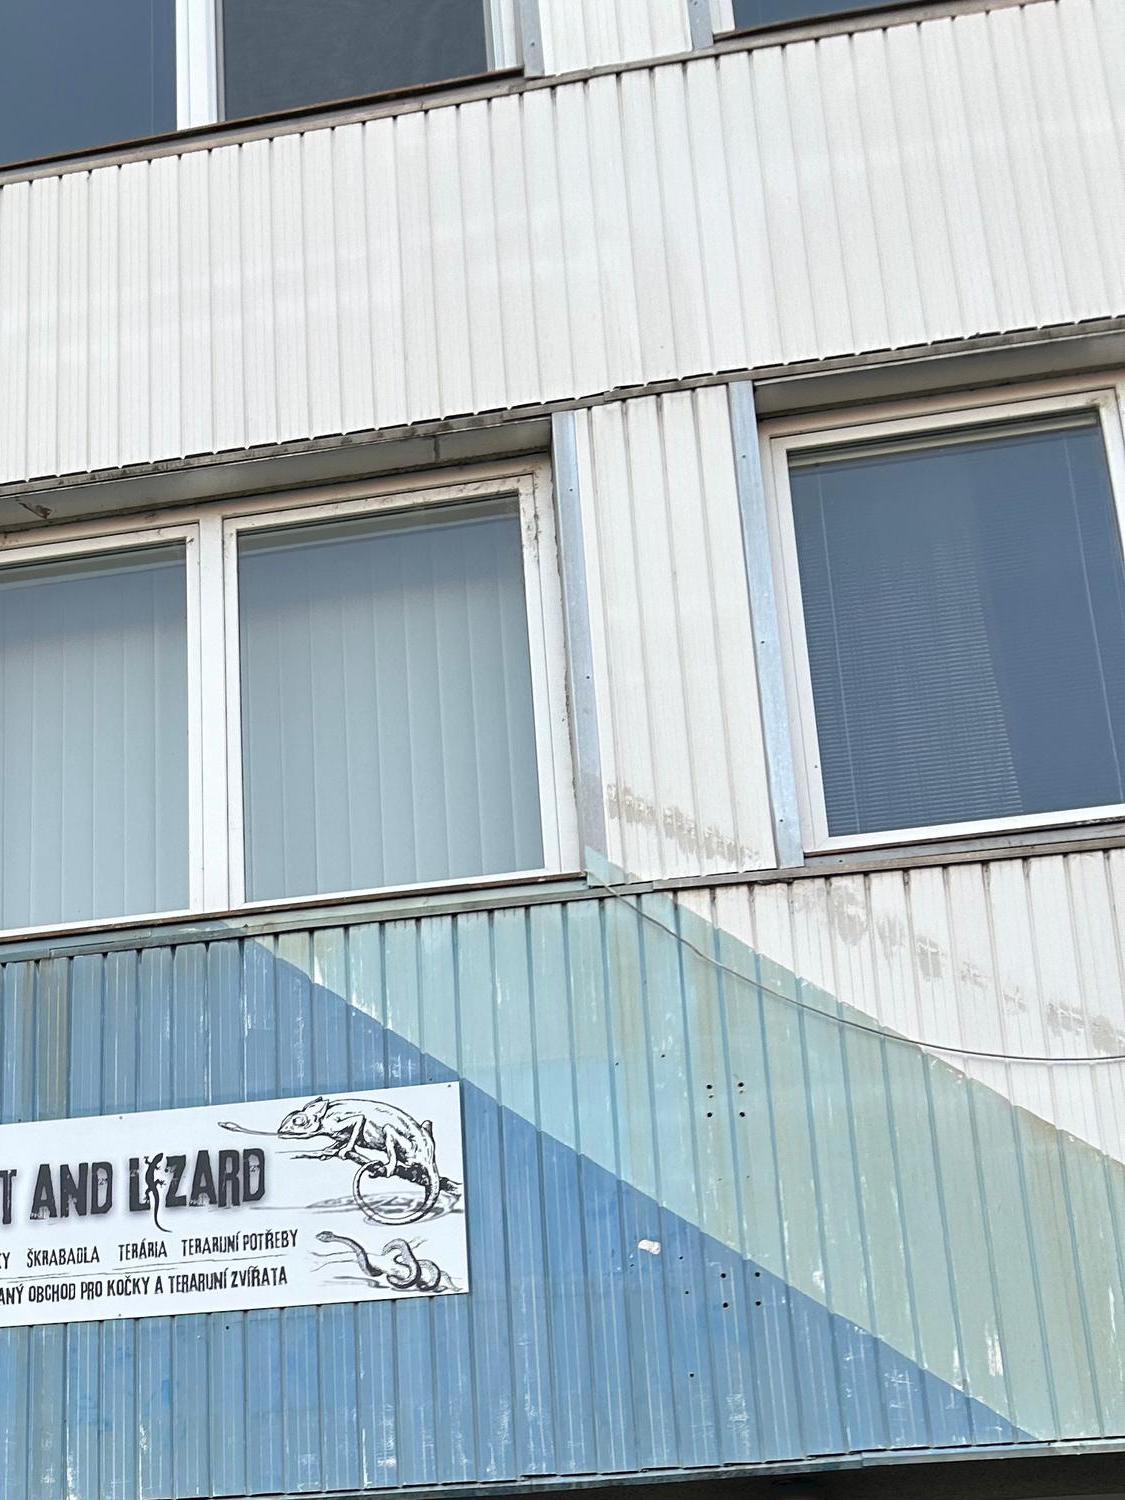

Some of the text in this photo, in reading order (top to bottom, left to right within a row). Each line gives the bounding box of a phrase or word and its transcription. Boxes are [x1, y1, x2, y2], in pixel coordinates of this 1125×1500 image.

[29, 1162, 113, 1220] AND
[26, 1245, 100, 1268] ŠKRABADLA
[118, 1238, 168, 1262] TERÁRIA
[242, 1228, 299, 1252] POTŘEBY
[28, 1282, 76, 1304] OBCHOD
[80, 1280, 103, 1301] PRO
[106, 1274, 150, 1297] KOČKY
[154, 1275, 164, 1295] A
[230, 1265, 288, 1289] ZVÍŘATA
